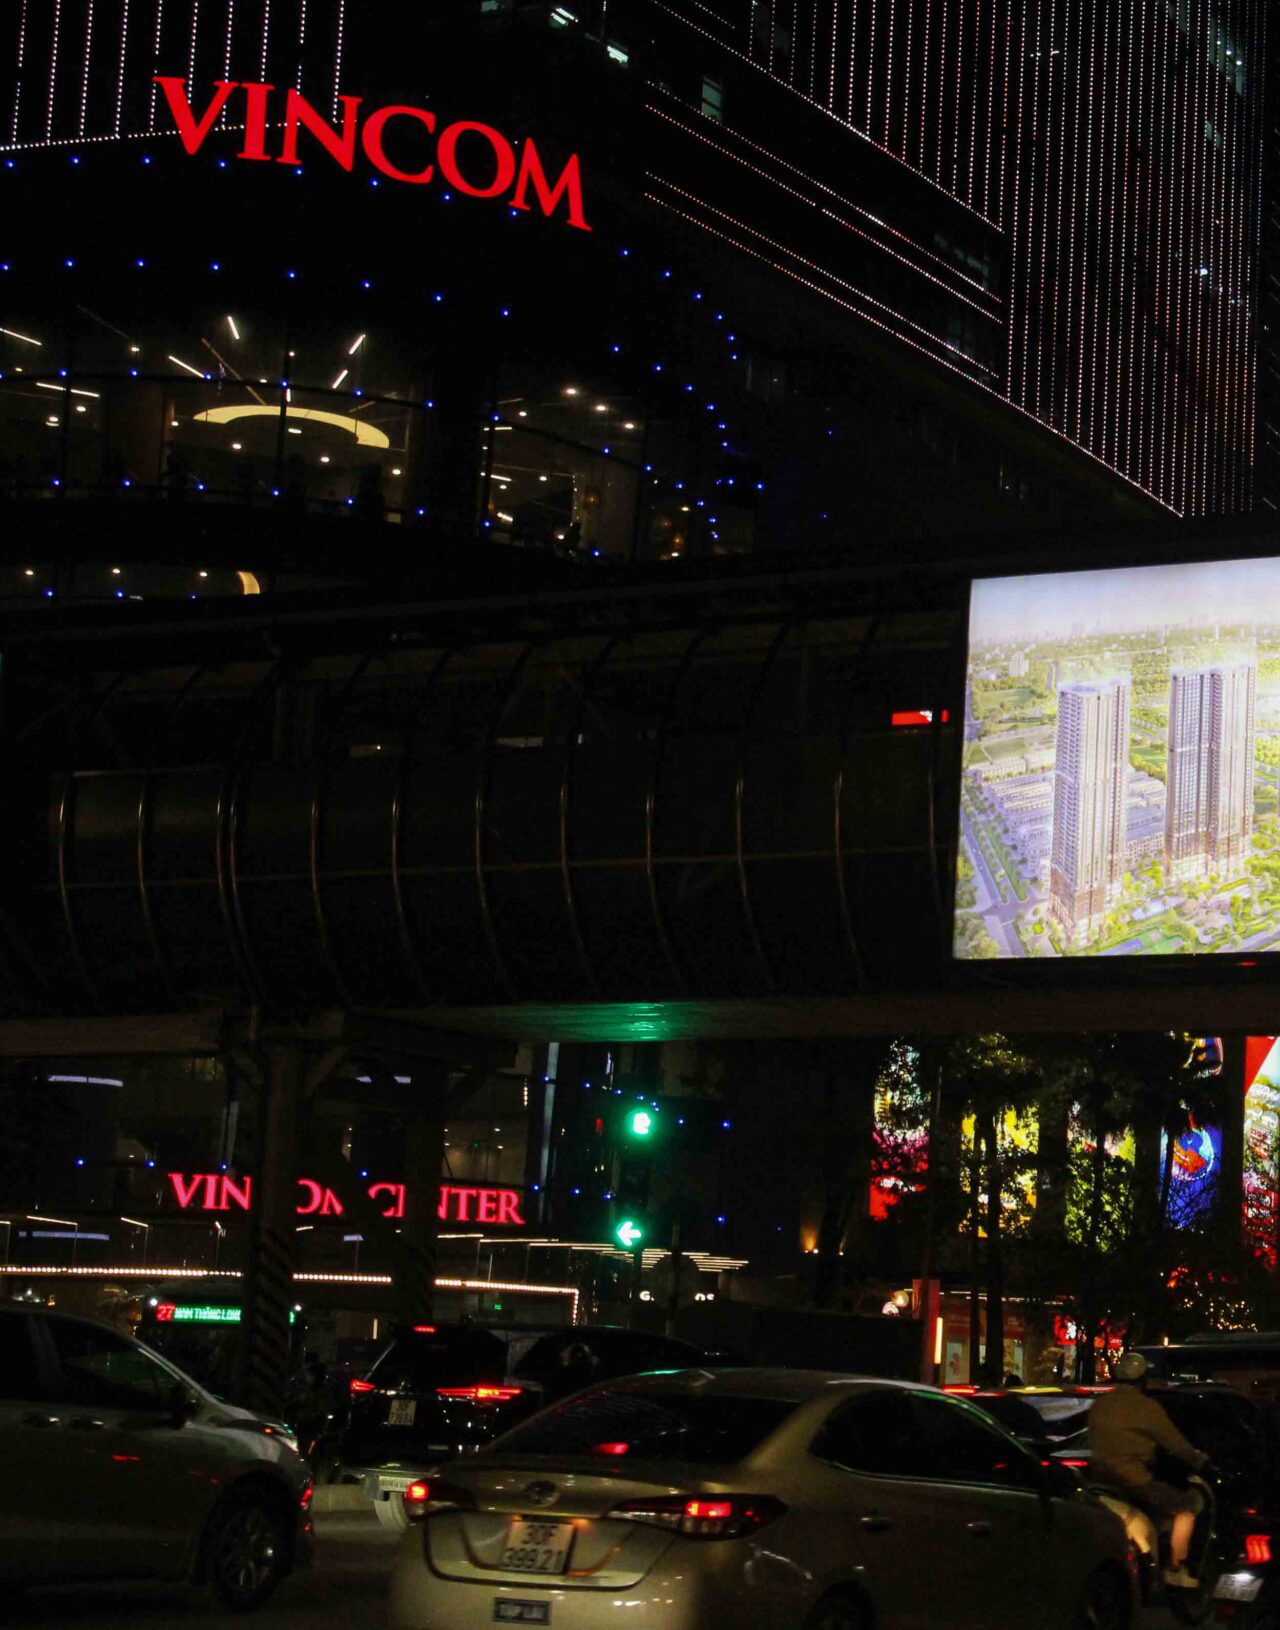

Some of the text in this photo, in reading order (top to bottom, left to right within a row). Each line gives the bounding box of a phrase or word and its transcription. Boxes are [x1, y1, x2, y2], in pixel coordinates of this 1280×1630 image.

[152, 76, 592, 231] VINCOM
[157, 1305, 175, 1321] 27
[522, 1524, 559, 1545] 30F
